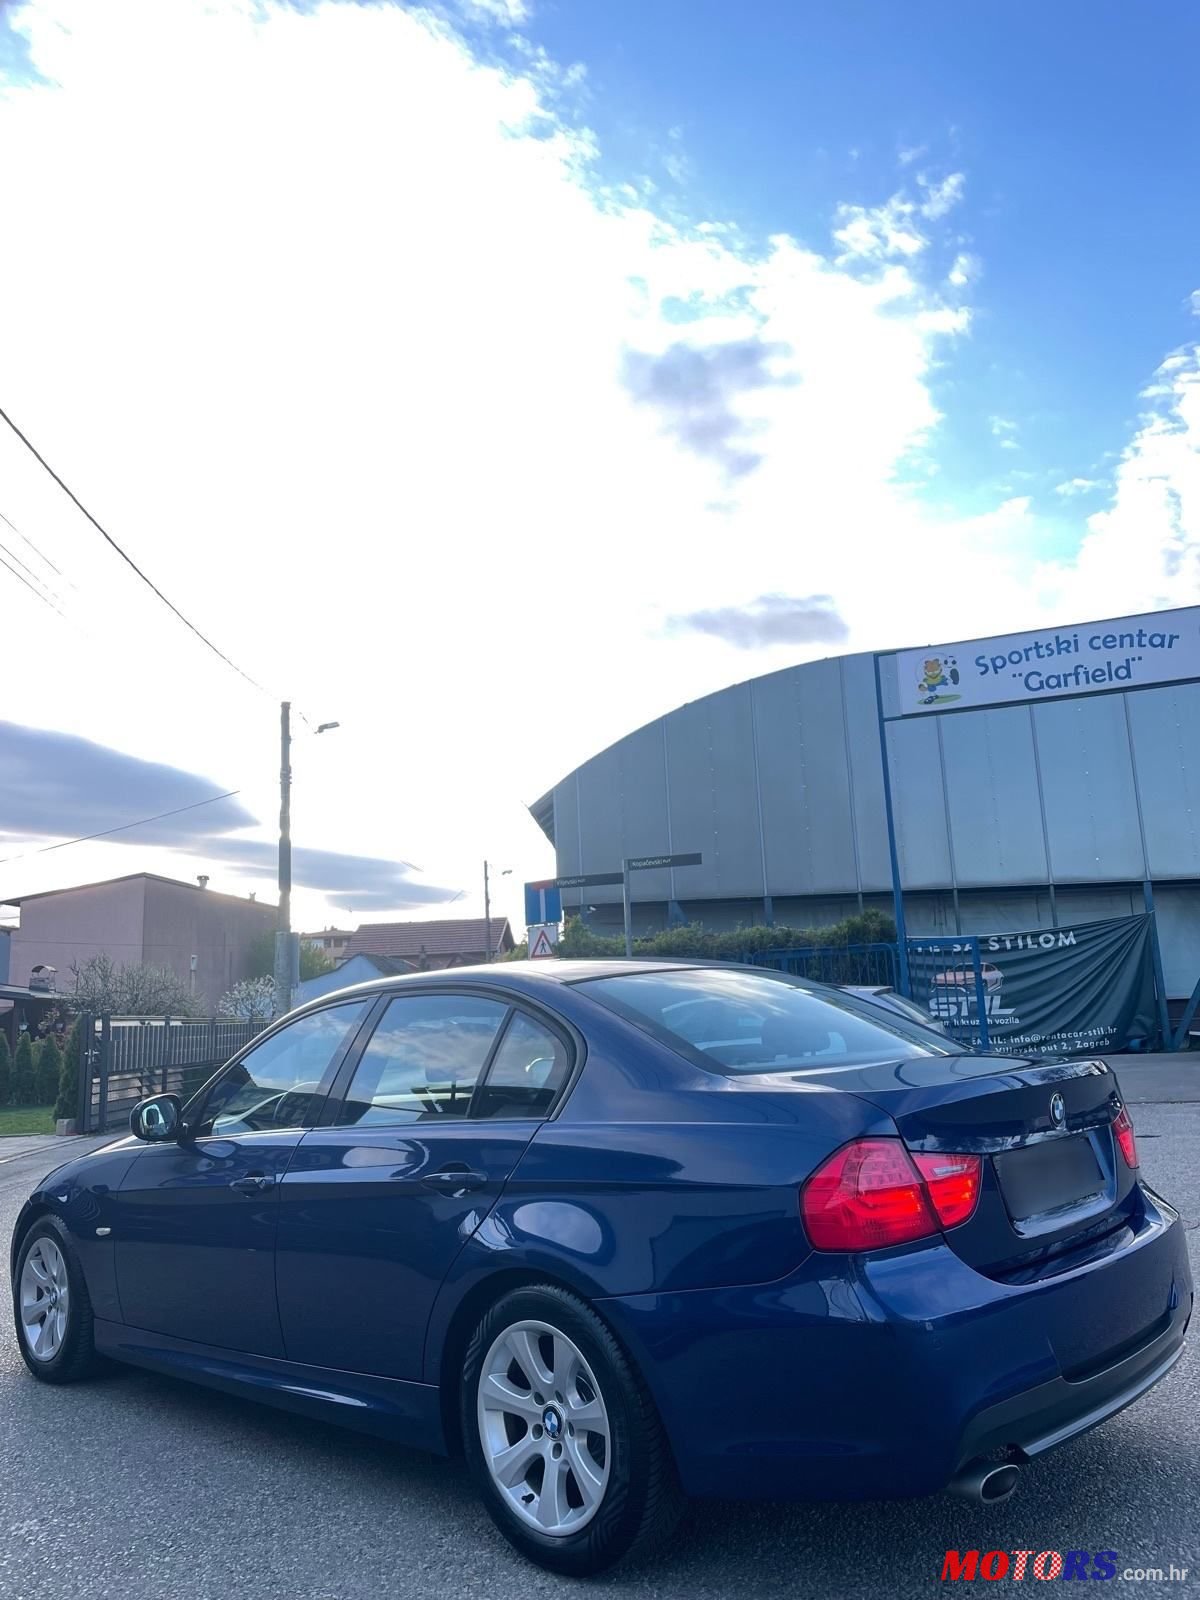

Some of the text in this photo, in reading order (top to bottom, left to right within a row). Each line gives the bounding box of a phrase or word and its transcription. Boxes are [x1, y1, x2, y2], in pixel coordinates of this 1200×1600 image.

[975, 629, 1180, 676] Sportski centar
[988, 931, 1077, 951] STILOM
[994, 1016, 1020, 1026] vozila
[1010, 1026, 1118, 1043] info@rentacar-stil.hr
[1040, 1044, 1058, 1054] put
[1061, 1041, 1072, 1051] 2,
[1076, 1038, 1110, 1049] Zagreb
